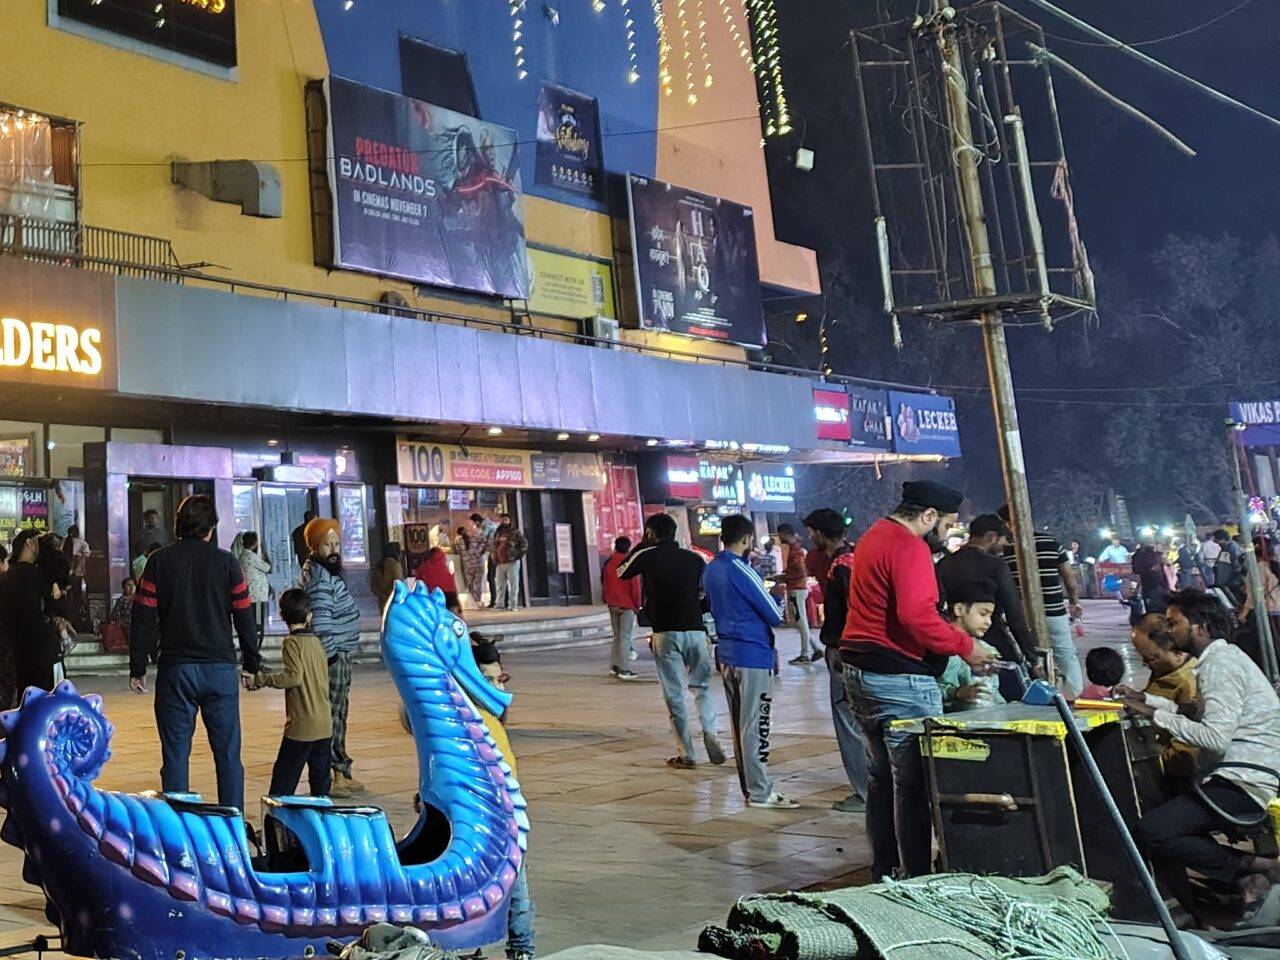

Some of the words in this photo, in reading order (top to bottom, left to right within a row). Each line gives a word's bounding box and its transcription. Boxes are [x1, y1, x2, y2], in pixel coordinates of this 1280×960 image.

[355, 136, 419, 175] PREDATOR
[340, 157, 436, 197] BADLANDS
[1238, 401, 1274, 423] VIKAS
[453, 467, 469, 479] USE
[470, 468, 491, 480] CODE
[759, 692, 772, 763] JORDAN
